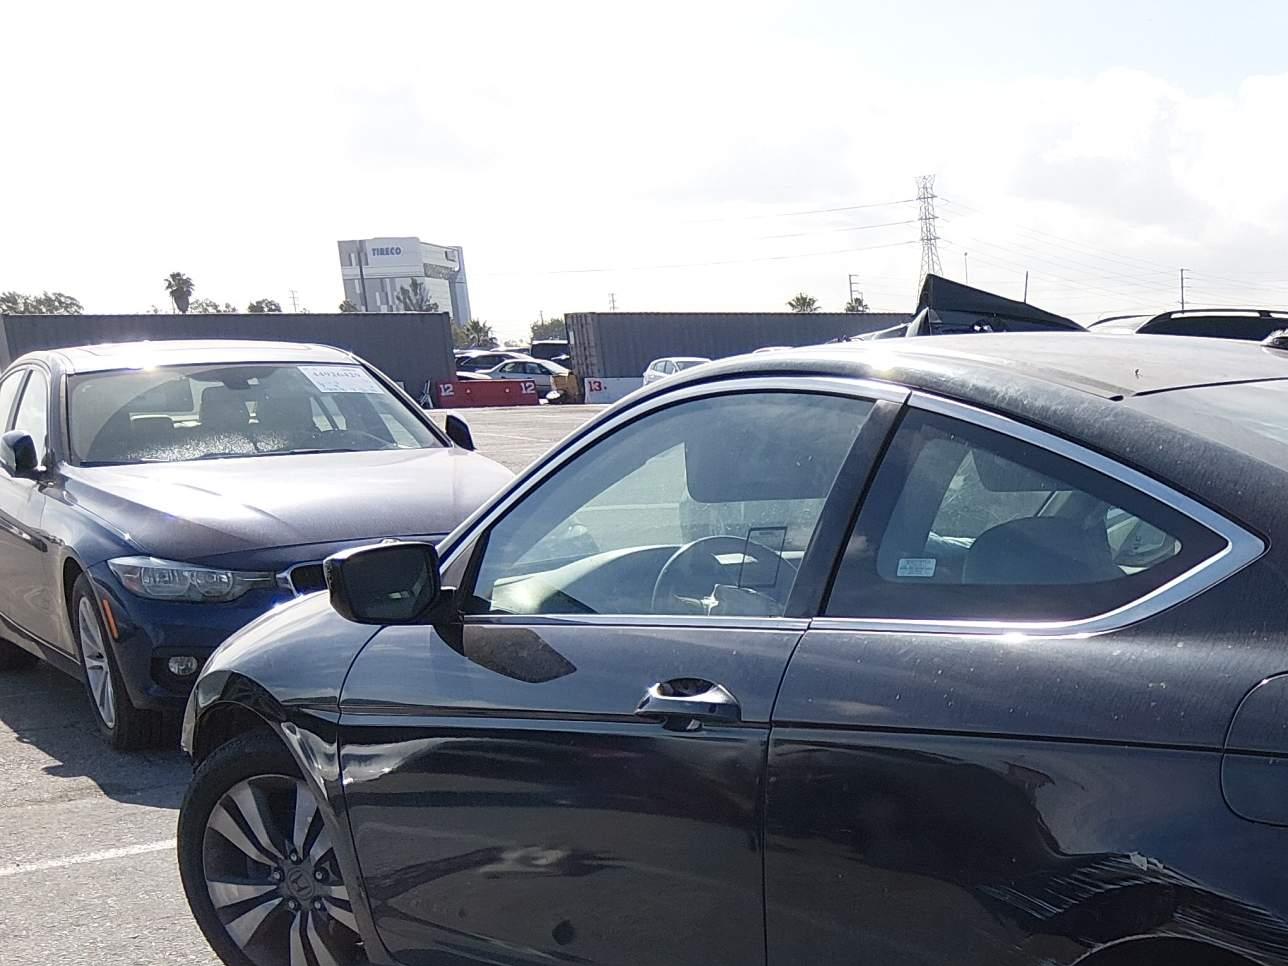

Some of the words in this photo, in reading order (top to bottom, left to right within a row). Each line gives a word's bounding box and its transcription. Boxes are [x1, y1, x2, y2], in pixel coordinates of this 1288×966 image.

[371, 246, 402, 256] TIRECO
[440, 383, 455, 396] 12
[520, 382, 536, 394] 12
